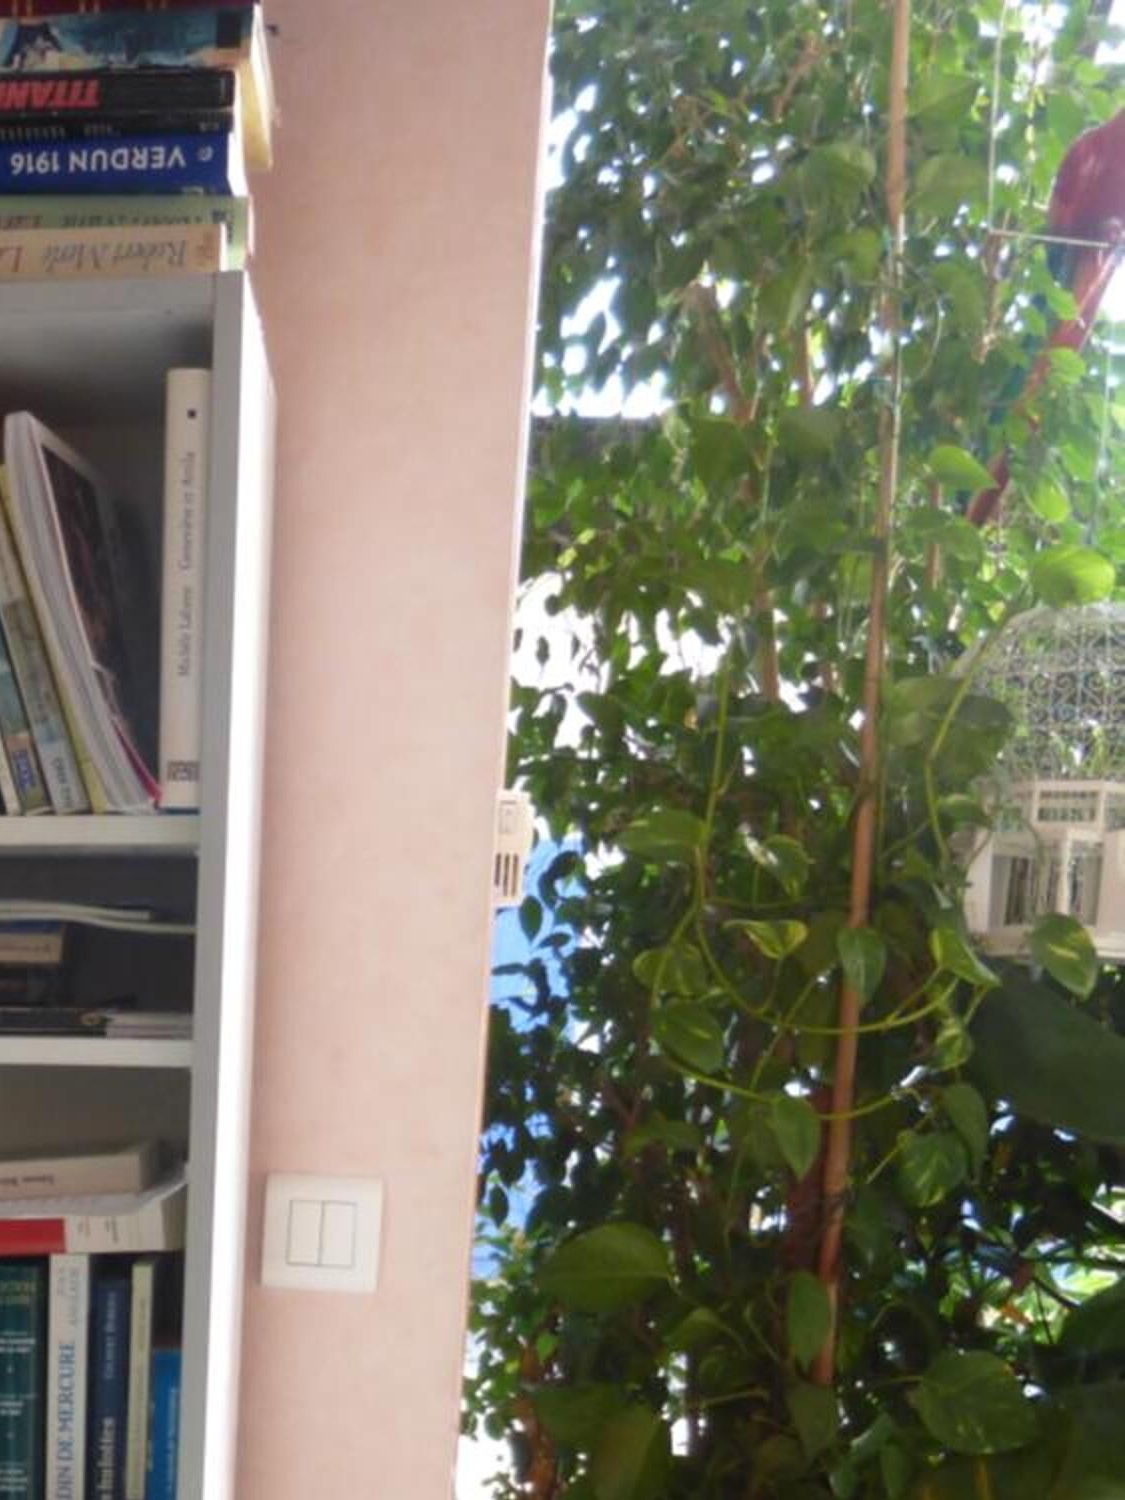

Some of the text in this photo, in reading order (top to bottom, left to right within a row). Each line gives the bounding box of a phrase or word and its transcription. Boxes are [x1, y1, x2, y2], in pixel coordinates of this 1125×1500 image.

[10, 145, 186, 176] VERDUN 1916
[57, 1342, 76, 1434] MERCURE
[55, 1438, 75, 1461] DE
